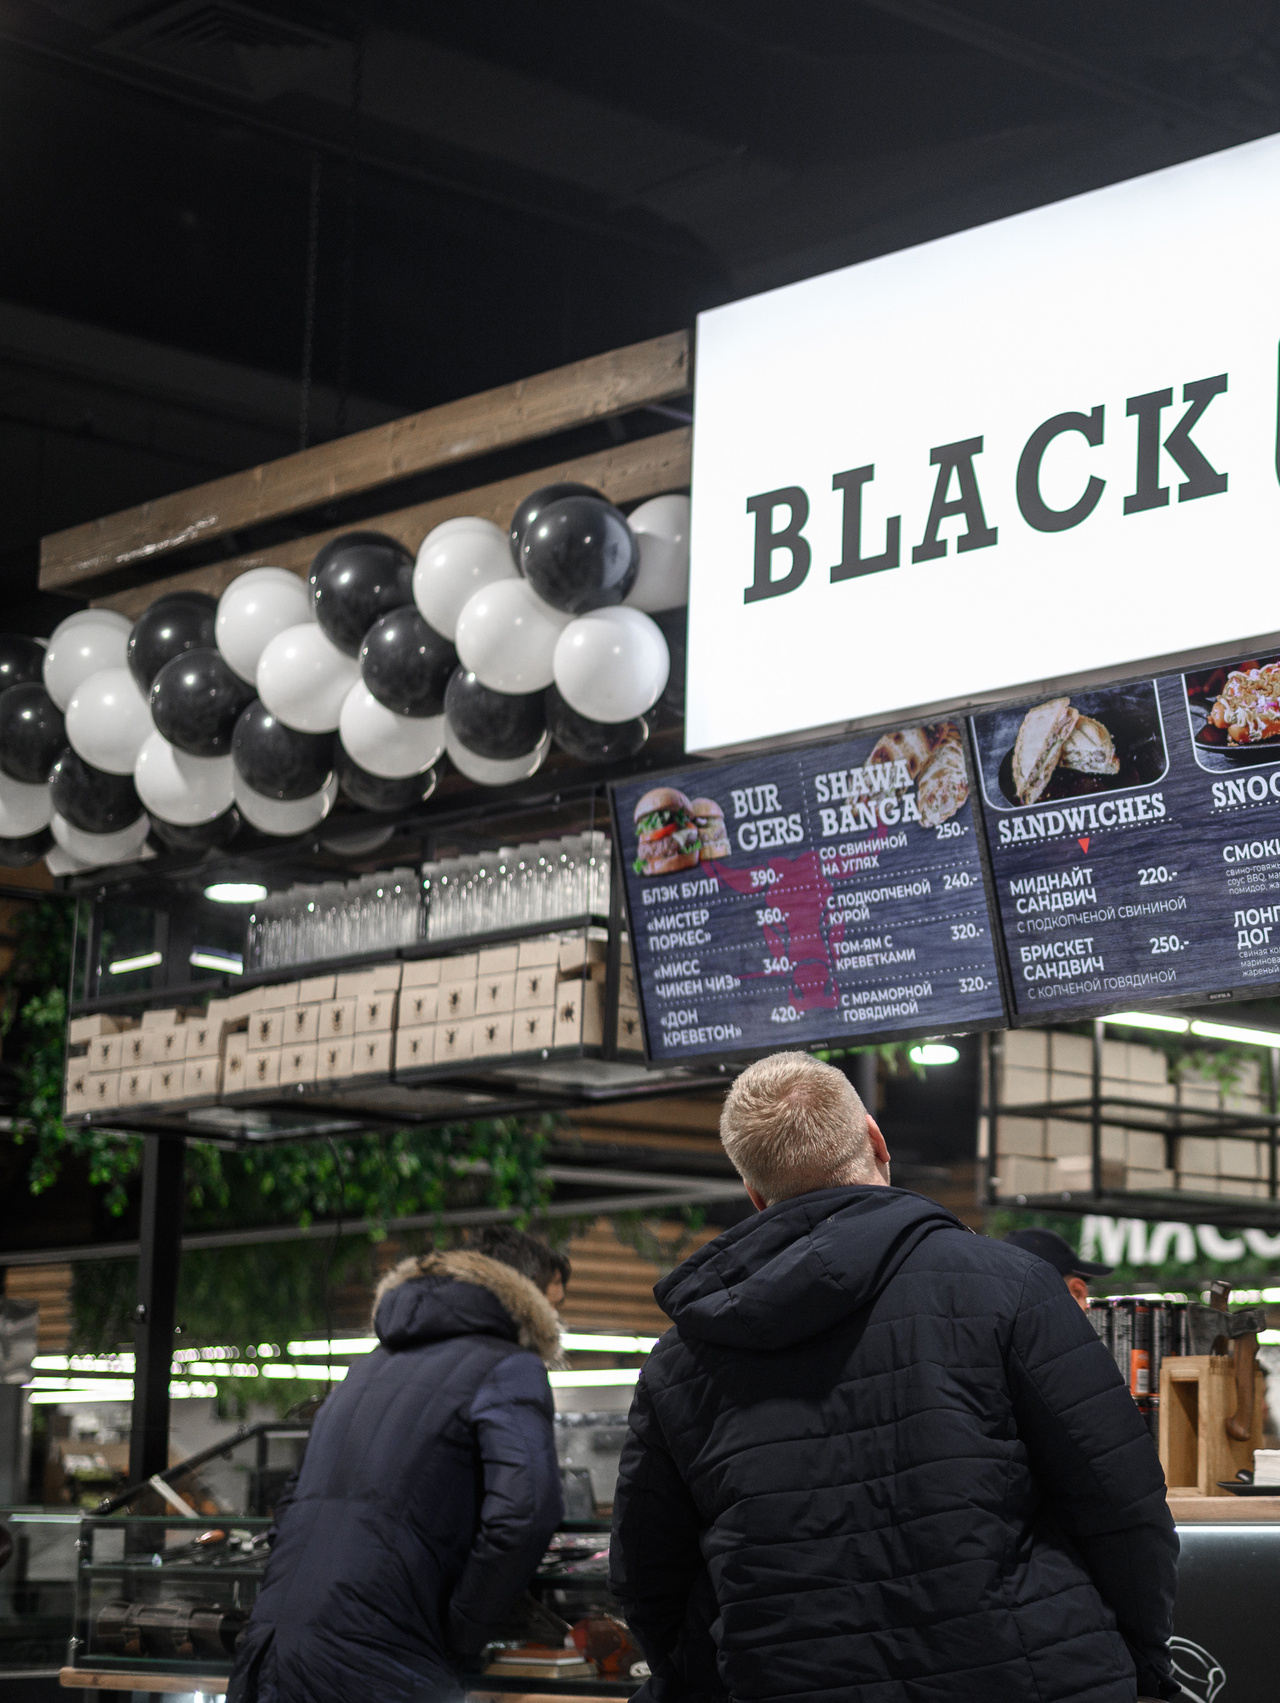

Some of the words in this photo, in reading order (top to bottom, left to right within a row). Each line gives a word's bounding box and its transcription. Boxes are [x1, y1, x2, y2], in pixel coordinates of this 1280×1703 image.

[744, 373, 1229, 605] BLACK
[815, 759, 914, 803] SHAWA
[731, 783, 782, 819] BUR
[819, 793, 922, 836] BANGA
[998, 792, 1166, 844] SANDWICHES
[738, 813, 804, 851] GERS
[819, 846, 836, 860] СО
[839, 831, 907, 856] СВИНИНОЙ
[822, 863, 840, 876] НА
[842, 855, 879, 873] УГЛЯХ
[642, 884, 679, 905] БЛЭК
[682, 878, 719, 899] БУЛЛ
[827, 897, 835, 908] С
[838, 879, 931, 907] ПОДКОПЧЕНОЙ
[1009, 866, 1093, 896] МИДНАЙТ
[1016, 887, 1097, 914] САНДВИЧ
[647, 909, 710, 932] «МИСТЕР
[829, 905, 870, 925] КУРОЙ
[1017, 921, 1025, 933] С
[1027, 906, 1116, 931] ПОДКОПЧЕНОЙ
[1118, 895, 1187, 919] СВИНИНОЙ
[649, 929, 712, 951] ПОРКЕС»
[834, 937, 882, 954] ТОМ-ЯМ
[885, 935, 893, 947] С
[1020, 938, 1094, 962] БРИСКЕТ
[1237, 927, 1273, 950] ДОГ
[654, 959, 701, 979] «МИСС
[836, 949, 916, 971] КРЕВЕТКАМИ
[1023, 956, 1104, 981] САНДВИЧ
[656, 979, 703, 998] ЧИКЕН
[705, 974, 741, 991] ЧИЗ»
[841, 994, 849, 1006] С
[852, 981, 933, 1004] МРАМОРНОЙ
[1028, 988, 1036, 1000] С
[1038, 978, 1101, 998] КОПЧЕНОЙ
[1103, 968, 1177, 989] ГОВЯДИНОЙ
[661, 1008, 699, 1028] «ДОН
[844, 999, 919, 1022] ГОВЯДИНОЙ
[663, 1024, 742, 1047] КРЕВЕТОН»
